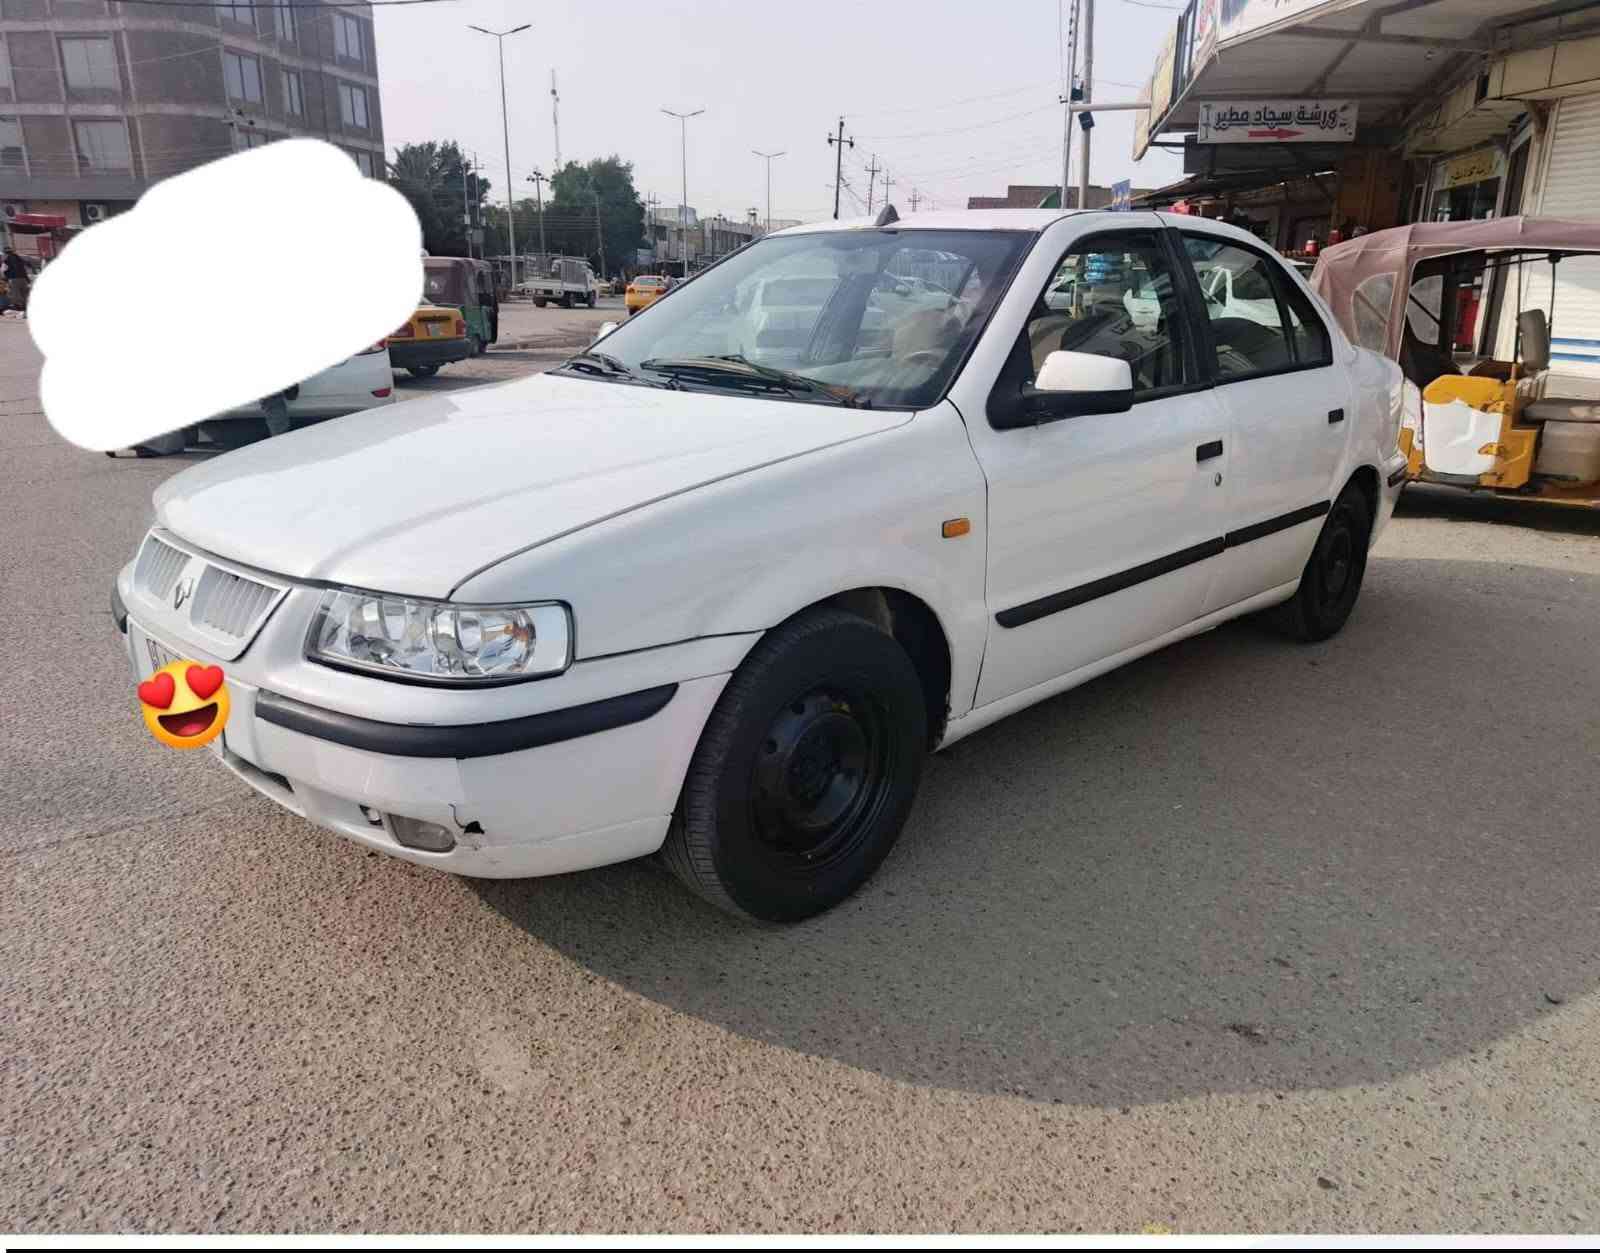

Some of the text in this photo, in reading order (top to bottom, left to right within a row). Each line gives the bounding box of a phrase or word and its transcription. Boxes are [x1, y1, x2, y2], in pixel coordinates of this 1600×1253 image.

[1214, 104, 1338, 130] ورشة سجاد مطير
